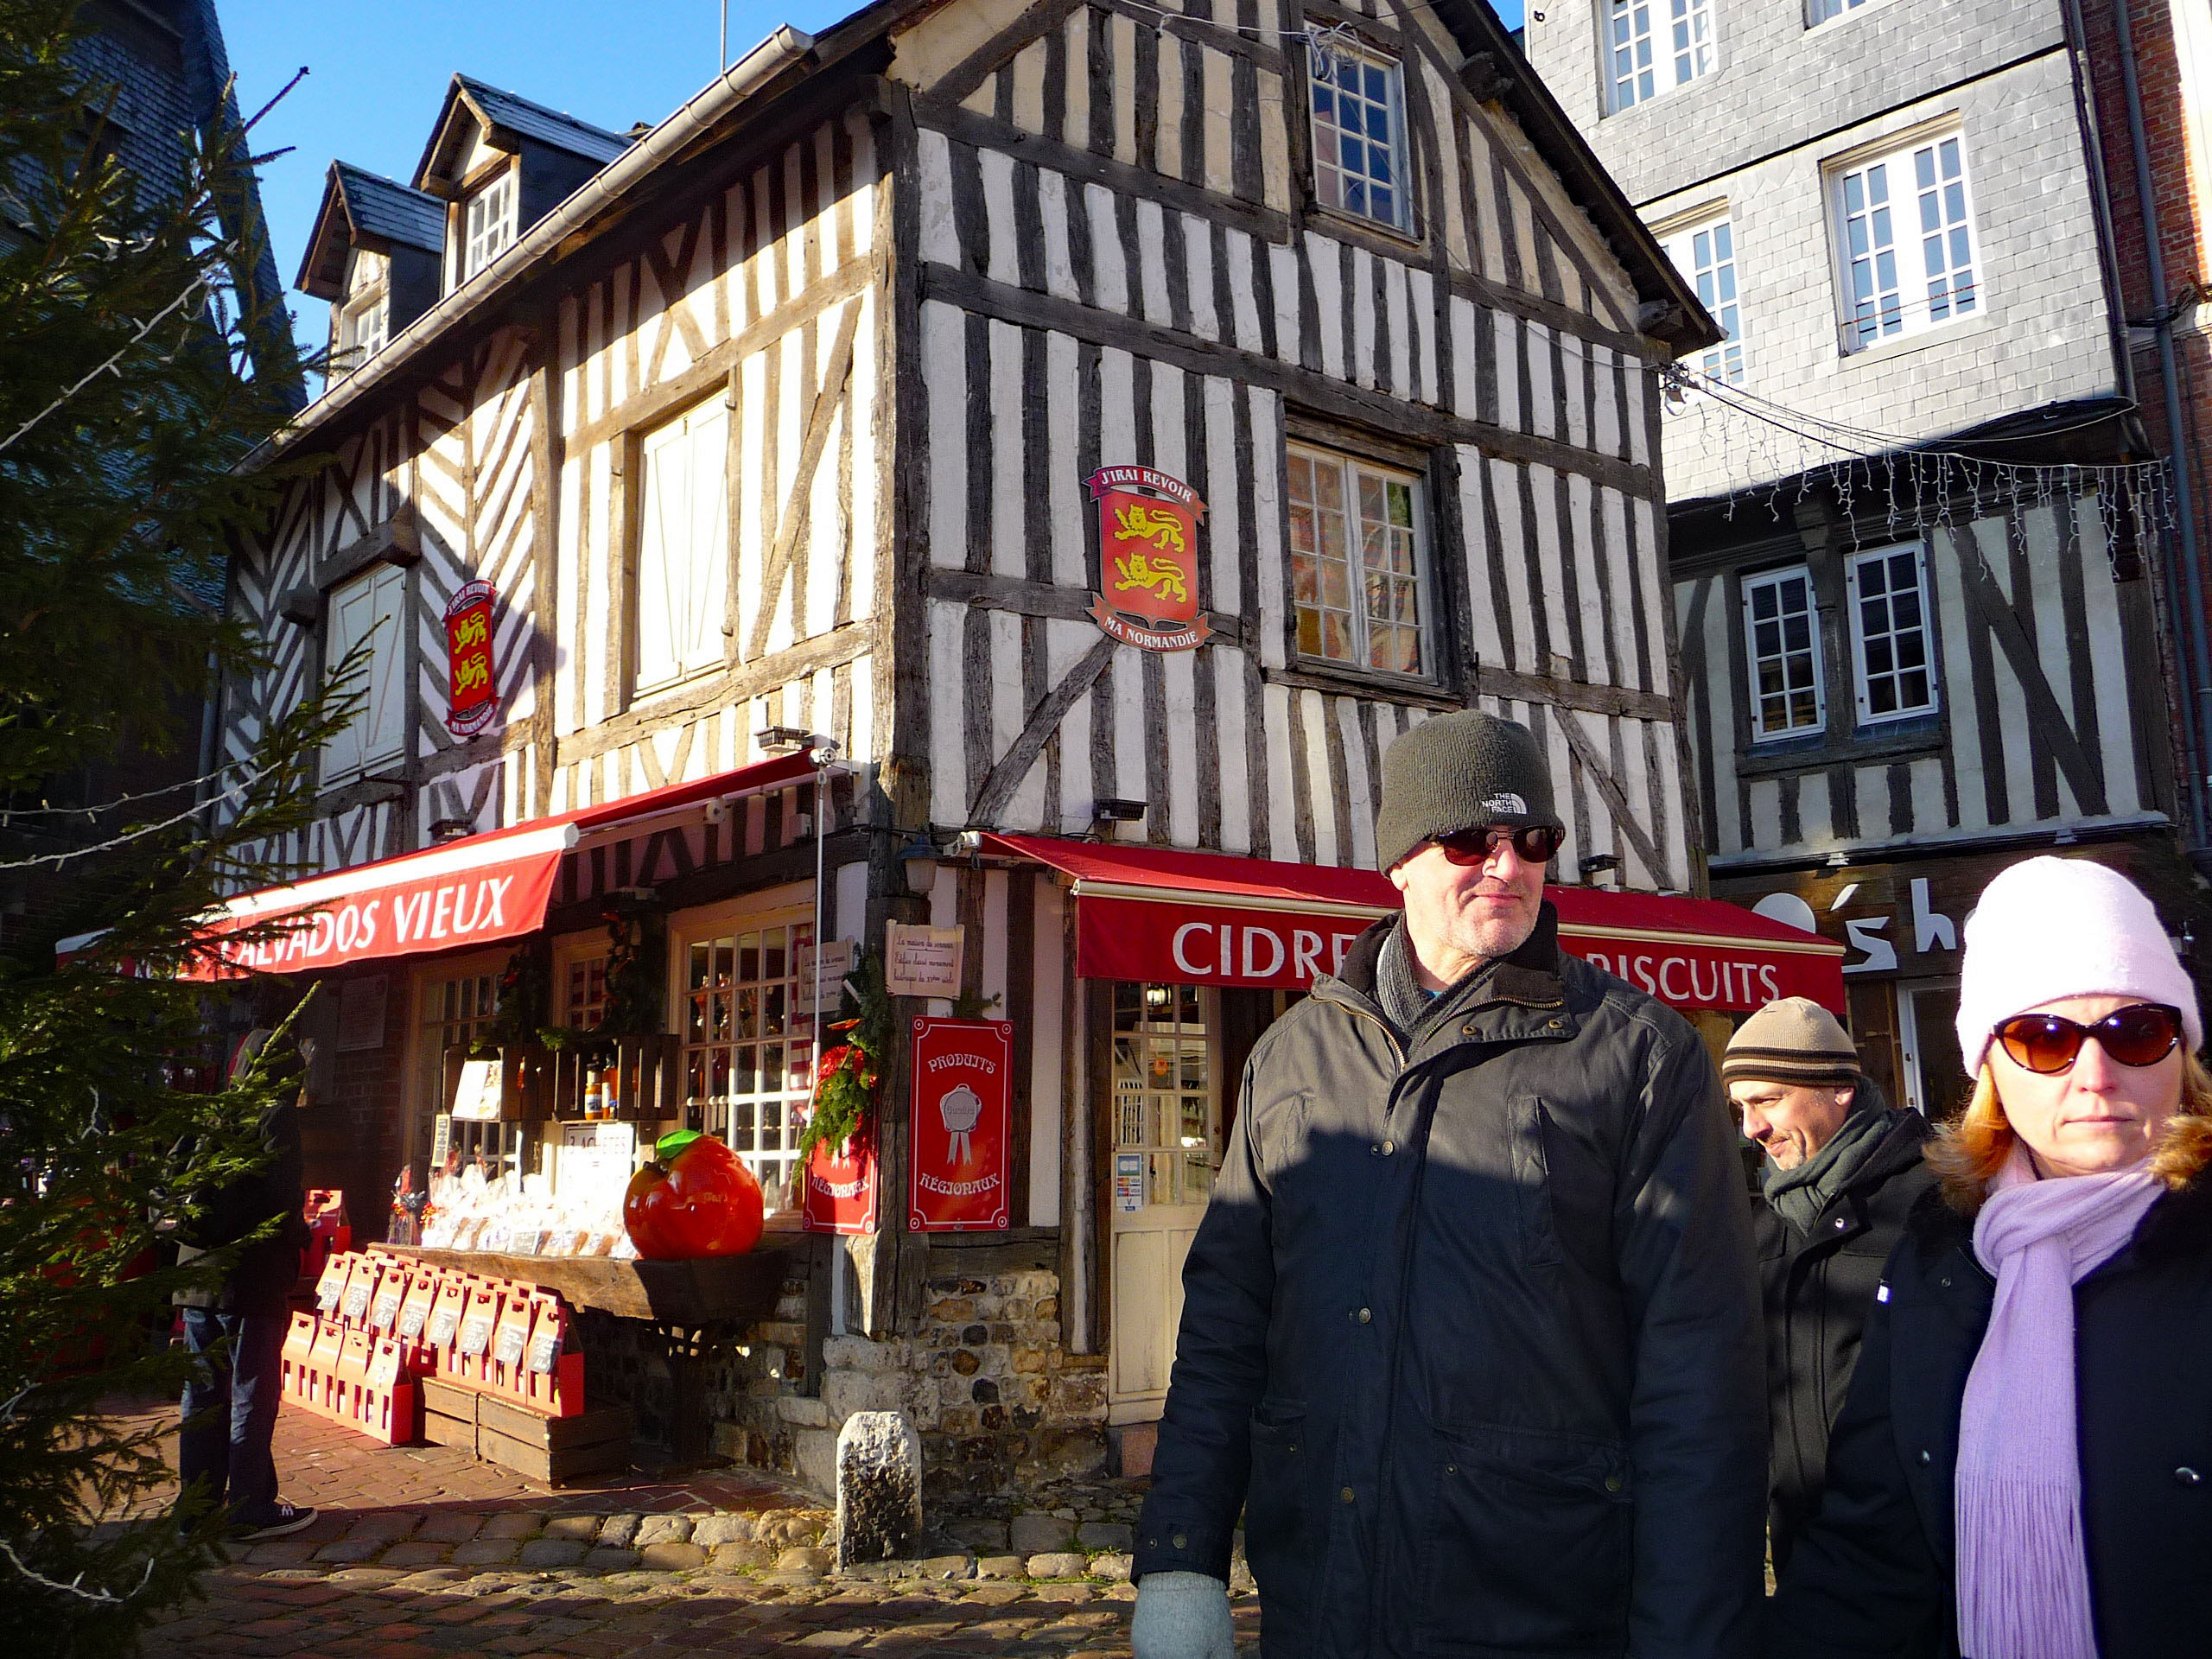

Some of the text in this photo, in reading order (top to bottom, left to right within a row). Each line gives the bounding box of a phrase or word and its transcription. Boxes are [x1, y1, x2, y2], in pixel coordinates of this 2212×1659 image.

[1101, 467, 1193, 503] J'IRAI REVOIR
[1103, 616, 1199, 648] MA NORMANDIE
[1481, 799, 1512, 808] NORTH
[394, 874, 513, 944] VIEUX
[927, 1053, 996, 1075] PRODUITS
[569, 1135, 577, 1154] 3
[919, 1172, 1001, 1197] RÉGIONAUX
